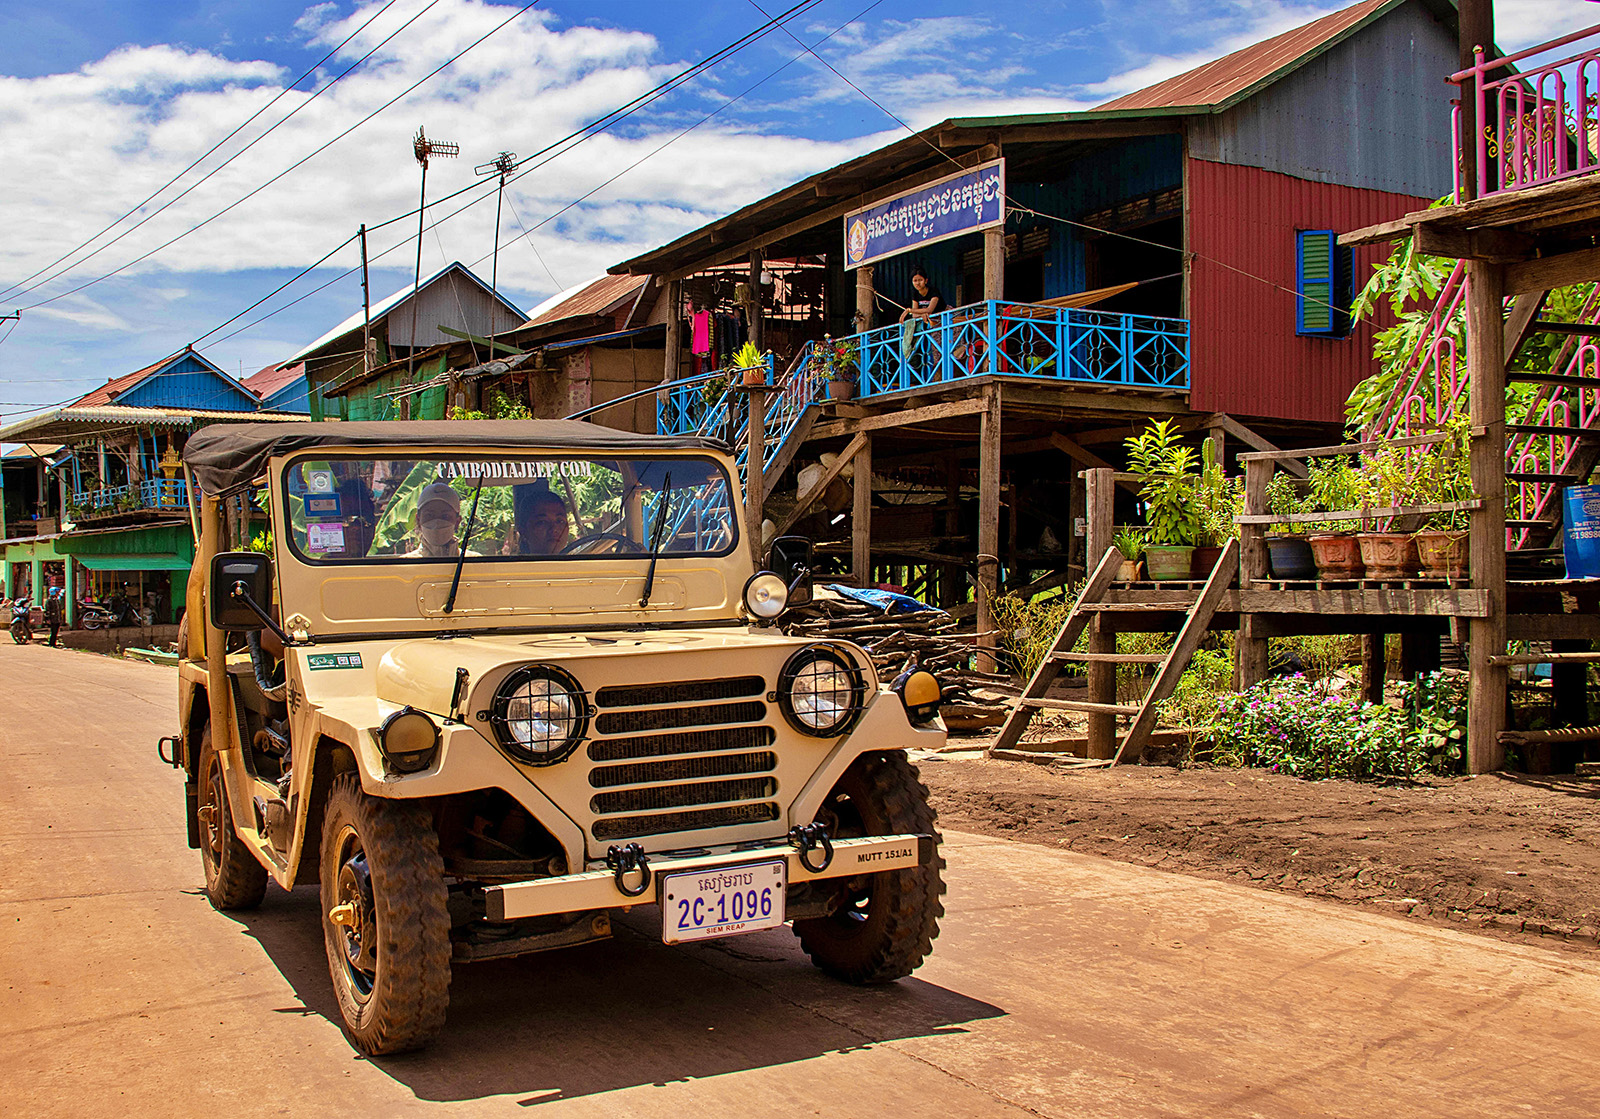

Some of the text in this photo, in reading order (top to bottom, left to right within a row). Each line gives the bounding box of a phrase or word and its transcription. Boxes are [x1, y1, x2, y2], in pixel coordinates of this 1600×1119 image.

[437, 461, 592, 478] CAMBODIAJEEP.COM
[857, 848, 913, 863] MUTT 151/A1
[698, 872, 754, 893] សៀមរាប
[677, 887, 772, 929] 2C-1096
[706, 923, 746, 934] SIEM REAP
